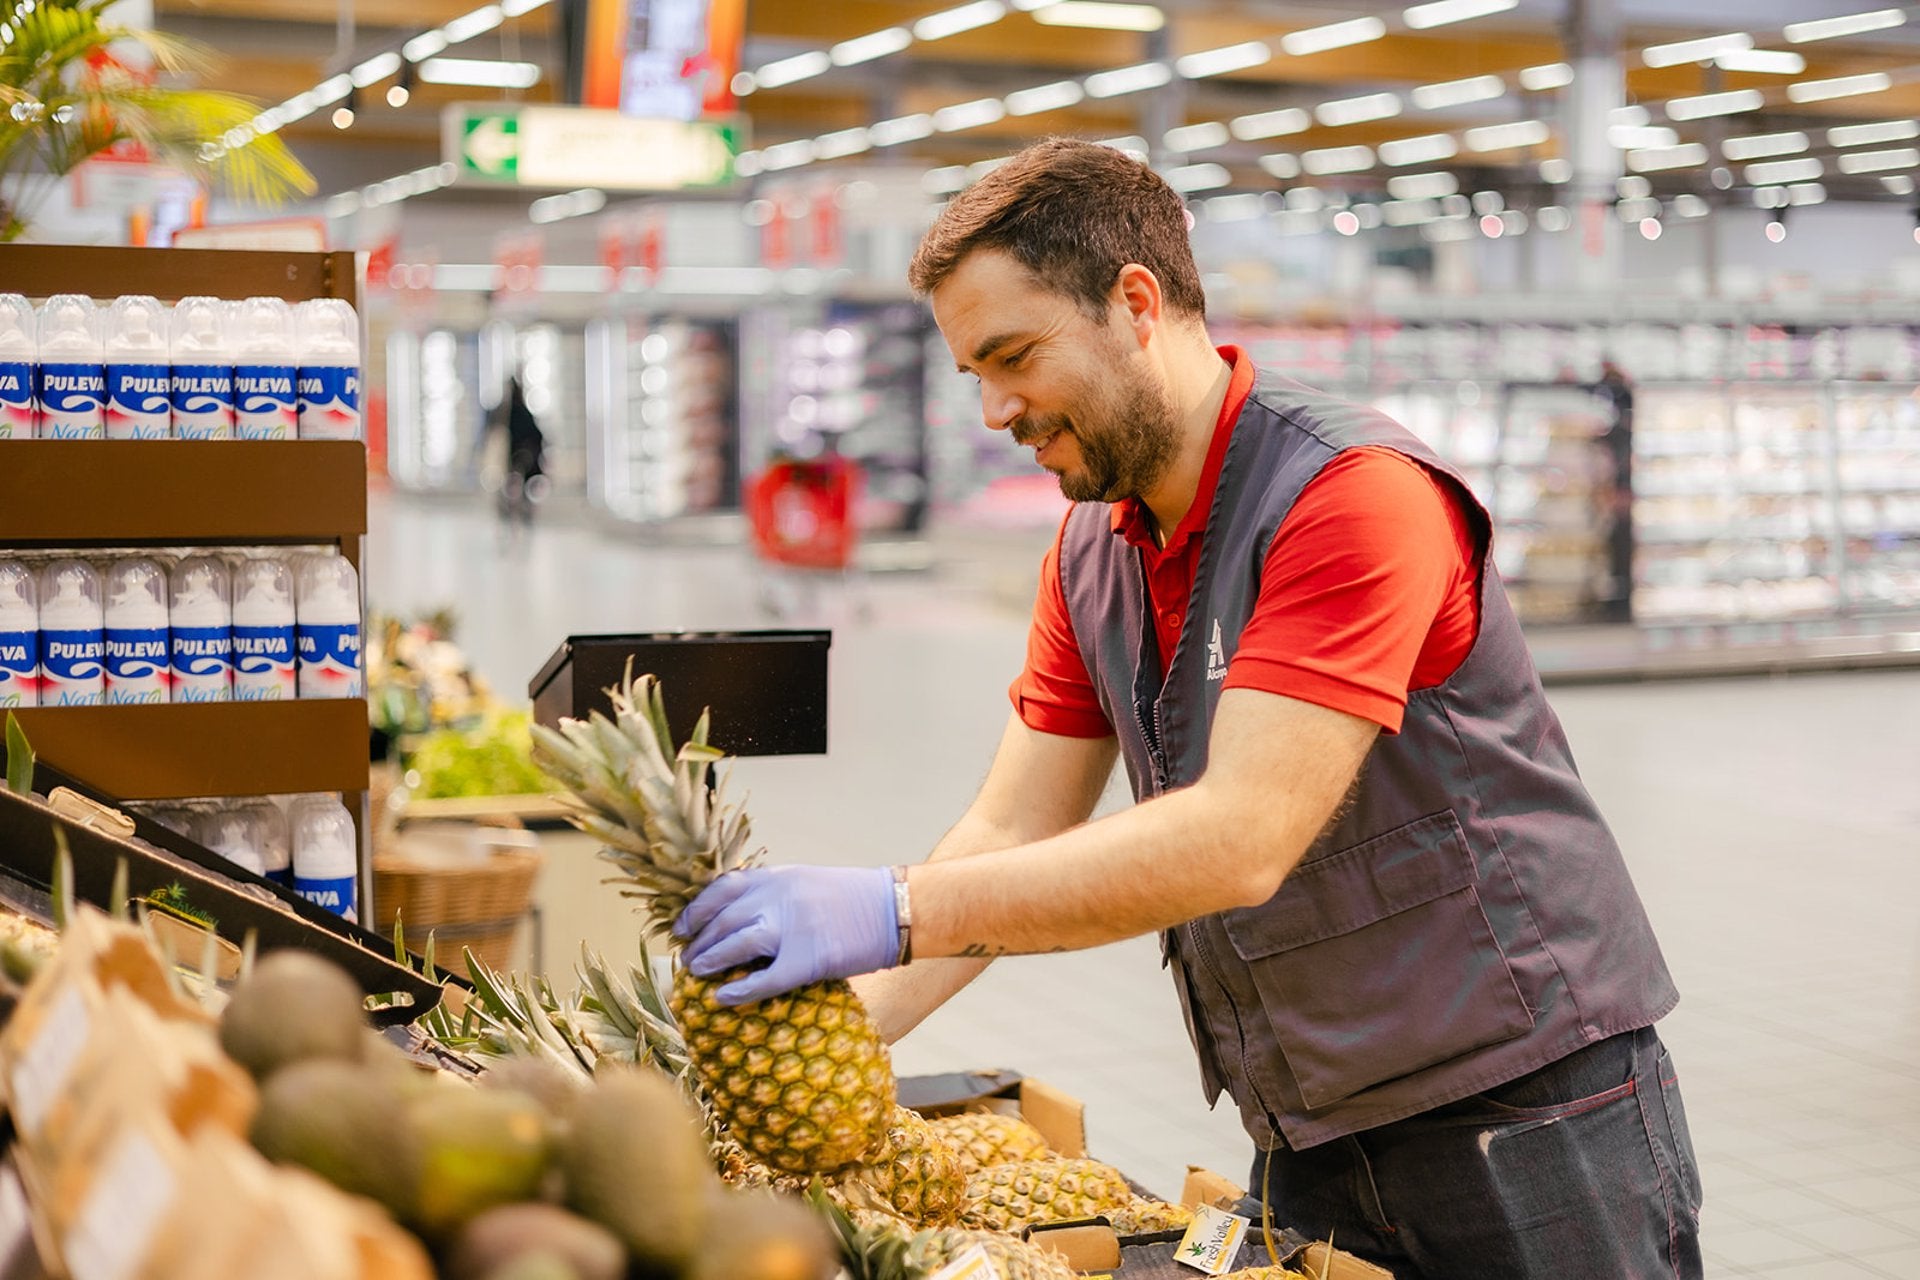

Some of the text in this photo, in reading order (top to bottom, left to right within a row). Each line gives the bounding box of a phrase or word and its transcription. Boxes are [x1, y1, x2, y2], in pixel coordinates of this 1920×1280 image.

[171, 376, 231, 393] PULEVA
[106, 640, 166, 657] PULEVA
[173, 638, 232, 655] PULEVA
